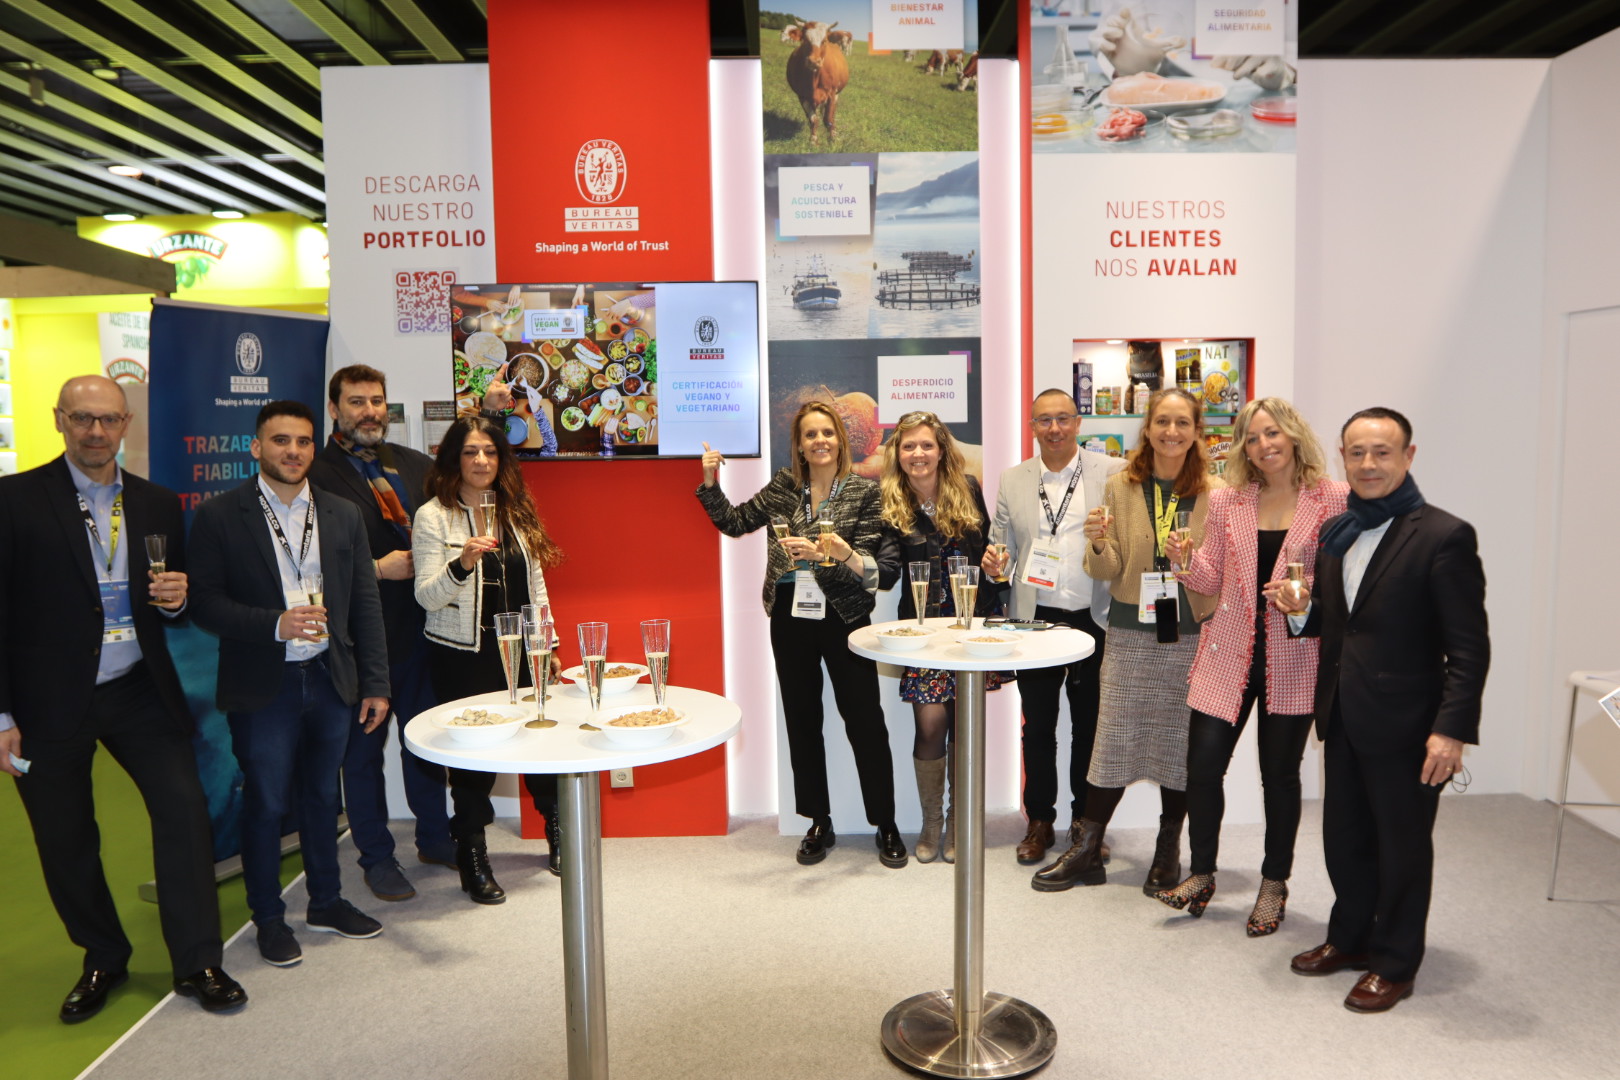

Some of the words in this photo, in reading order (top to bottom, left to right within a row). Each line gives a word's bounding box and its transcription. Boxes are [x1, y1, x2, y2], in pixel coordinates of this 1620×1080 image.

[890, 2, 944, 12] BIENESTAR
[1214, 8, 1266, 17] SEGURIDAD
[898, 16, 936, 25] ANIMAL
[1208, 22, 1272, 31] ALIMENTARIA
[578, 141, 598, 174] BUREAU
[601, 141, 624, 174] VERITAS
[365, 174, 480, 194] DESCARGA
[804, 183, 834, 192] PESCA
[838, 183, 844, 191] Y
[792, 196, 856, 205] ACUICULTURA
[373, 202, 474, 221] NUESTRO
[571, 208, 632, 218] BUREAU
[794, 210, 854, 219] SOSTENIBLE
[1106, 200, 1226, 219] NUESTROS
[572, 220, 632, 230] VERITAS
[364, 228, 486, 249] PORTFOLIO
[1110, 230, 1222, 248] CLIENTES
[151, 234, 225, 258] URZANTE
[535, 242, 579, 254] Shaping
[590, 241, 624, 252] World
[626, 240, 638, 251] of
[640, 240, 670, 251] Trust
[1095, 258, 1138, 277] NOS
[1147, 258, 1238, 276] AVALAN
[1204, 344, 1230, 360] NAT
[672, 380, 744, 390] CERTIFICACIÓN
[892, 378, 954, 387] DESPERDICIO
[684, 392, 722, 400] VEGANO
[891, 391, 955, 400] ALIMENTARIO
[214, 398, 238, 407] Shaping
[676, 404, 740, 412] VEGETARIANO
[183, 434, 257, 454] TRAZAB
[258, 495, 280, 530] HOSTELCO
